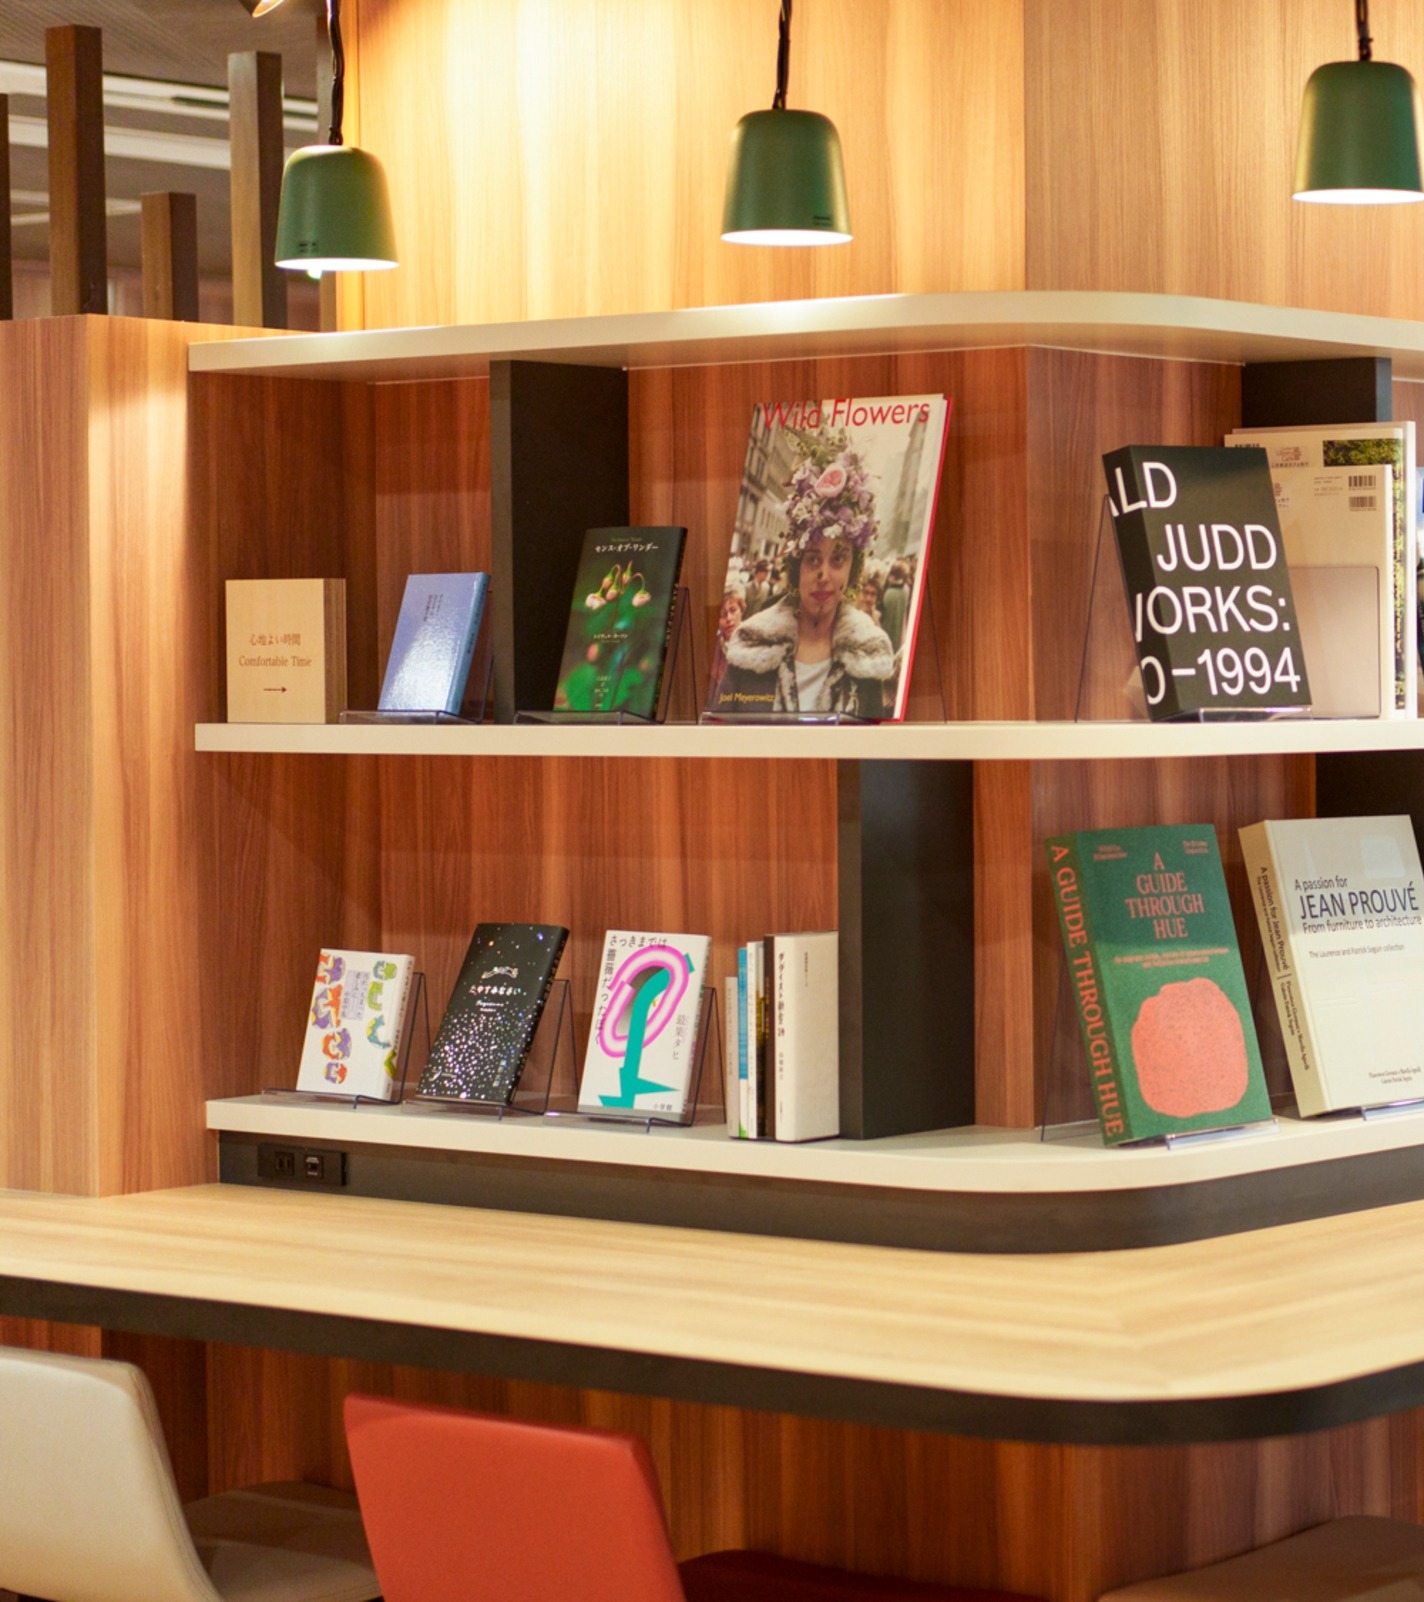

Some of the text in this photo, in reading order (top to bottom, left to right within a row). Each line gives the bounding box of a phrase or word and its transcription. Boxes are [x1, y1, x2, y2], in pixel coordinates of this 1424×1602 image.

[762, 397, 931, 429] Wild Flowers
[1108, 461, 1178, 518] LD
[1157, 523, 1277, 572] JUDD
[1135, 584, 1290, 643] ORKS:
[249, 633, 301, 646] 心地よい時間
[238, 655, 312, 667] Comfortable Time
[719, 693, 776, 704] Joel Meyerowitz
[1153, 851, 1166, 871] A
[1260, 866, 1268, 874] A
[1135, 871, 1188, 895] GUIDE
[1261, 874, 1274, 907] passion
[1294, 875, 1348, 893] A passion for
[1124, 893, 1206, 919] THROUGH
[1299, 880, 1420, 920] JEAN PROUVÉ
[1152, 917, 1189, 940] HUE
[1273, 920, 1281, 940] Jean
[1302, 914, 1422, 935] From furniture to architecture
[1277, 939, 1290, 971] Prouvé
[1309, 943, 1405, 959] The Laurence and Patrick Seguin collection
[1051, 845, 1125, 1138] A GUIDE THROUGH HUE
